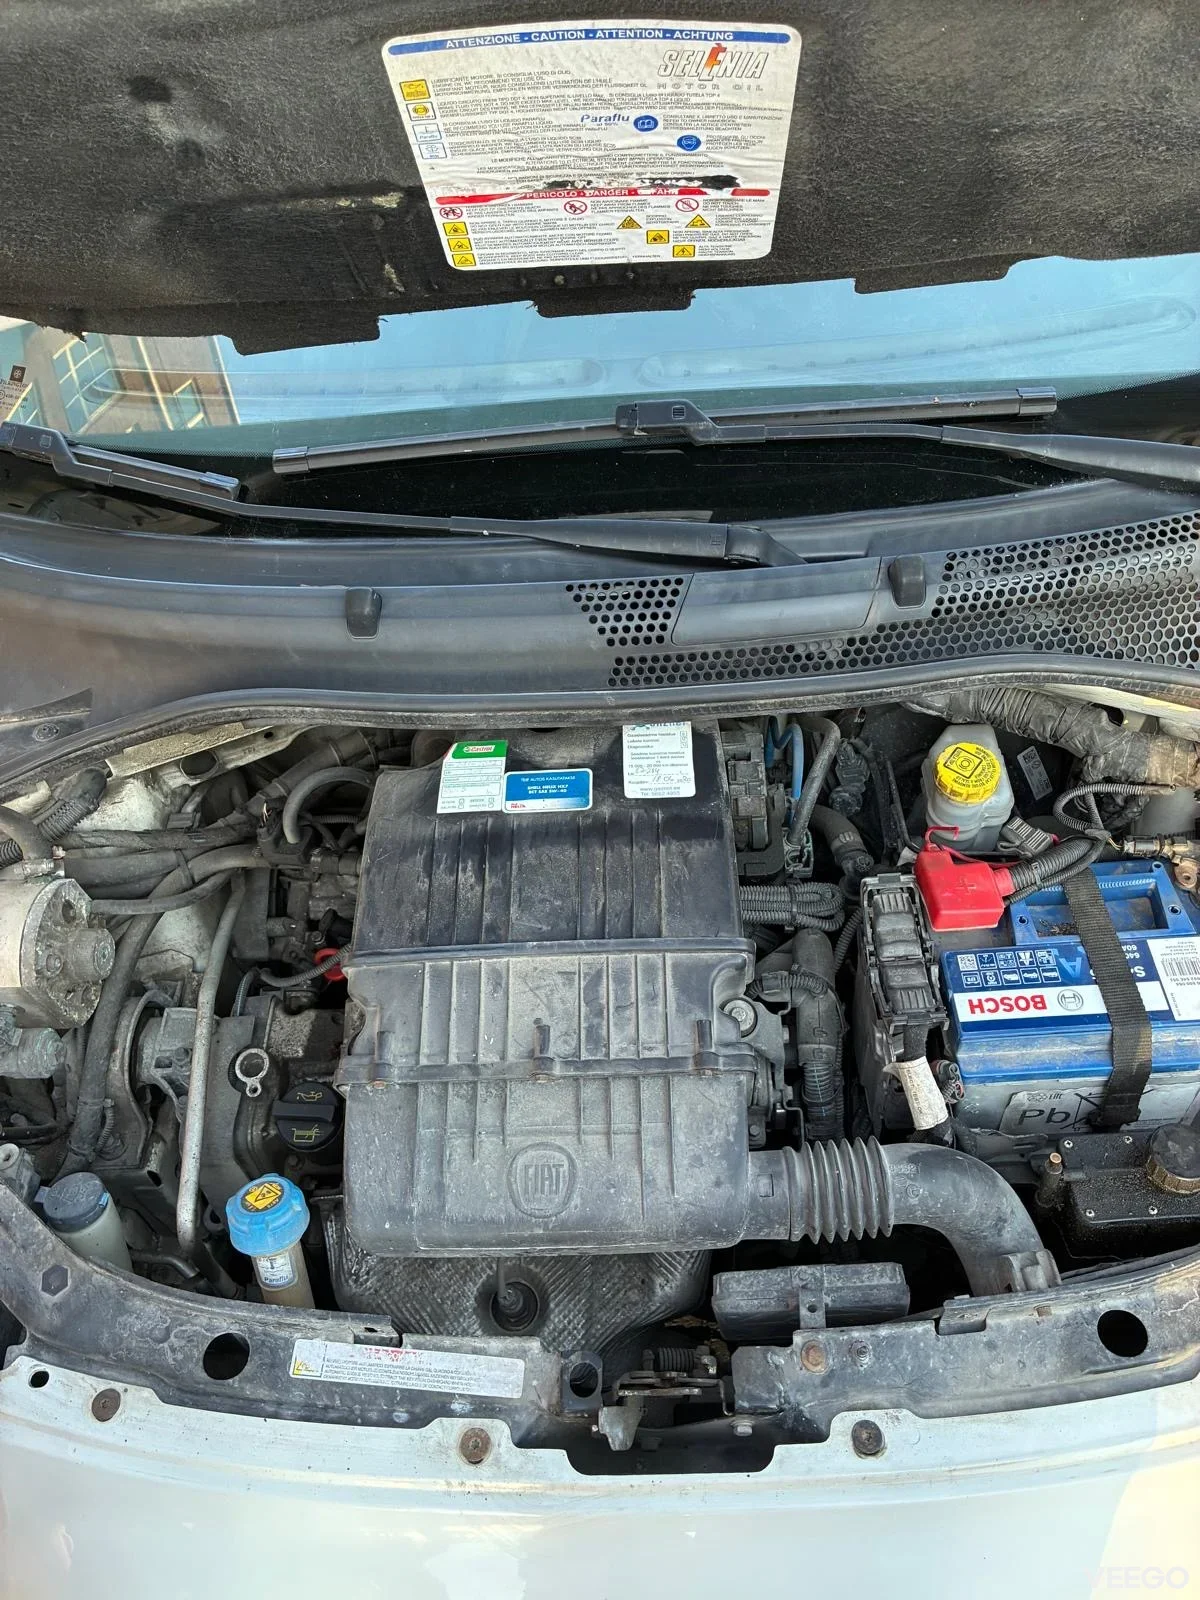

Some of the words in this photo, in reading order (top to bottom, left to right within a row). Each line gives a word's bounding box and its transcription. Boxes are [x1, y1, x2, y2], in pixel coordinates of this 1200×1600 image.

[446, 34, 520, 48] ATTENZIONE
[531, 30, 585, 41] CAUTION
[596, 29, 662, 39] ATTENTION
[673, 31, 734, 41] ACHTUNG
[656, 82, 720, 90] MOTOR
[732, 83, 763, 91] OIL
[580, 114, 630, 122] Paraflu
[968, 994, 1048, 1016] BOSCH
[1016, 1107, 1070, 1125] Pb
[524, 1163, 564, 1196] FIAT
